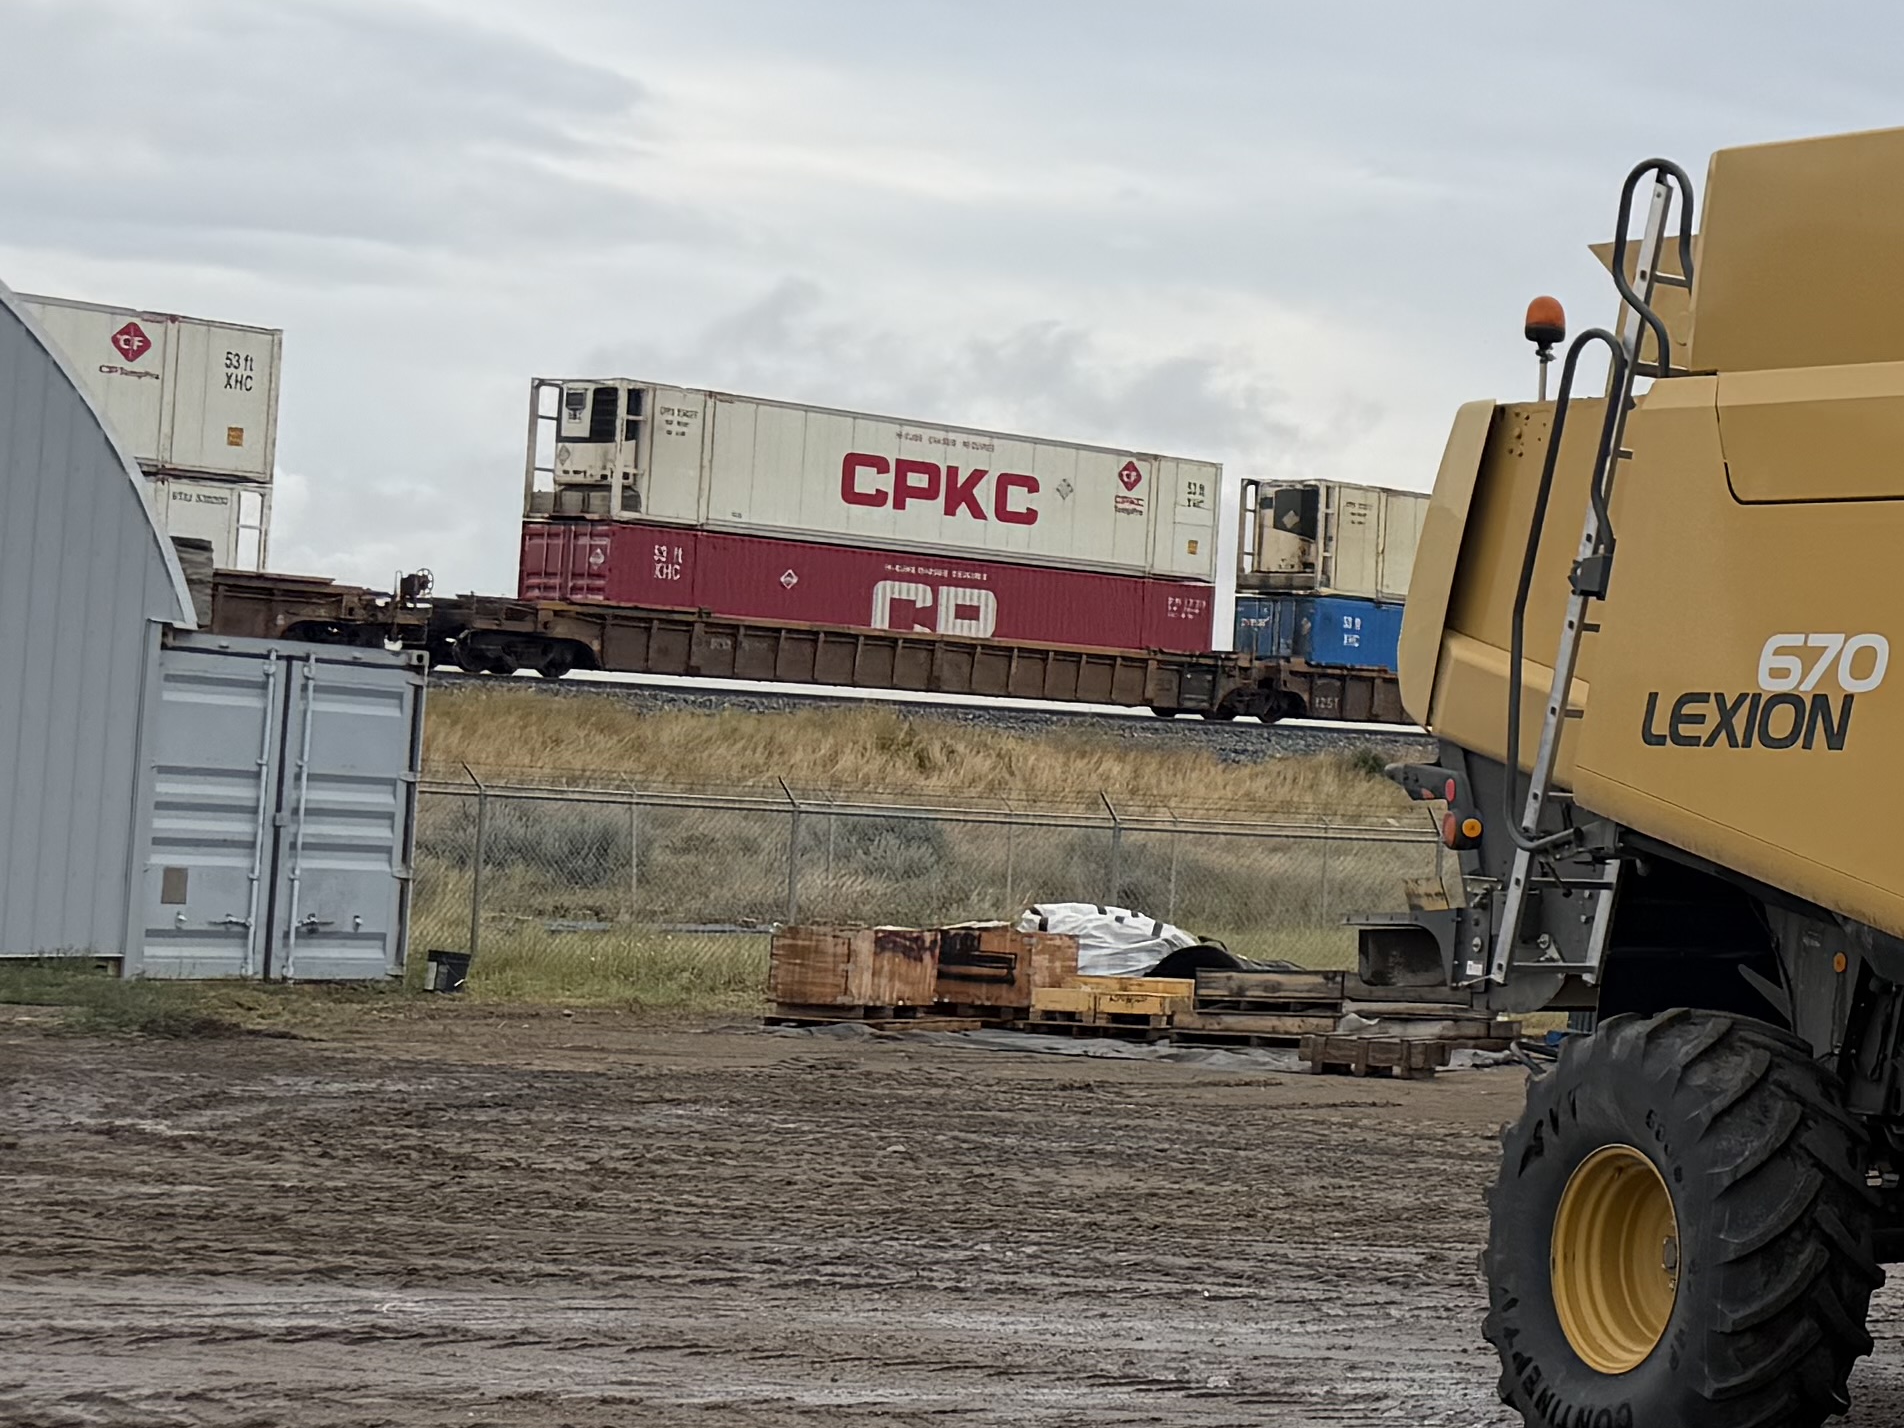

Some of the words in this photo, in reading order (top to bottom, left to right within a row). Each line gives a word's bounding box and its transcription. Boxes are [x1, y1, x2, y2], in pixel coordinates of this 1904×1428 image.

[224, 373, 253, 392] XHC
[225, 351, 241, 370] 53
[244, 355, 254, 372] ft
[840, 452, 1040, 526] CPKC
[871, 580, 998, 639] CP
[1758, 633, 1889, 692] 670
[1642, 691, 1854, 751] LEXION
